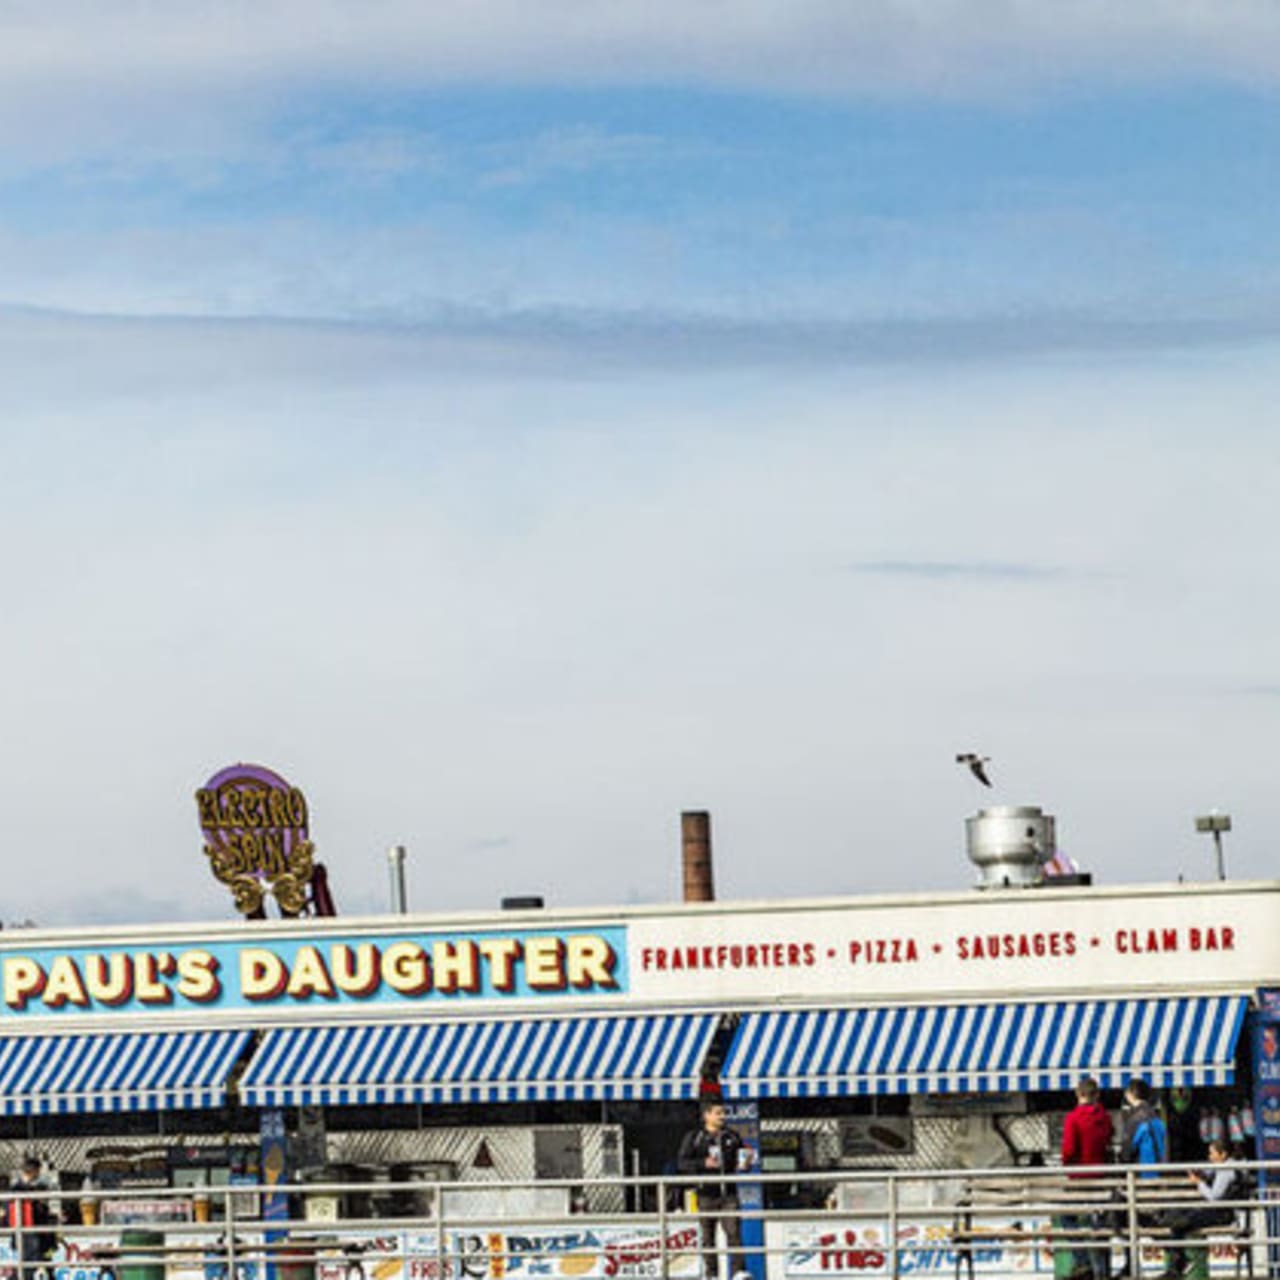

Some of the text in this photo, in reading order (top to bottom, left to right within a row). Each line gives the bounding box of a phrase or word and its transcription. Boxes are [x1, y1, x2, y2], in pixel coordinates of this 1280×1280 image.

[196, 787, 307, 829] ELECTRO
[229, 832, 288, 876] SPIN
[2, 931, 622, 1010] PAUL'S DAUGHTER
[642, 926, 1235, 971] FRANKFURTERS PIZZA SAUSAGES CLAM BAR
